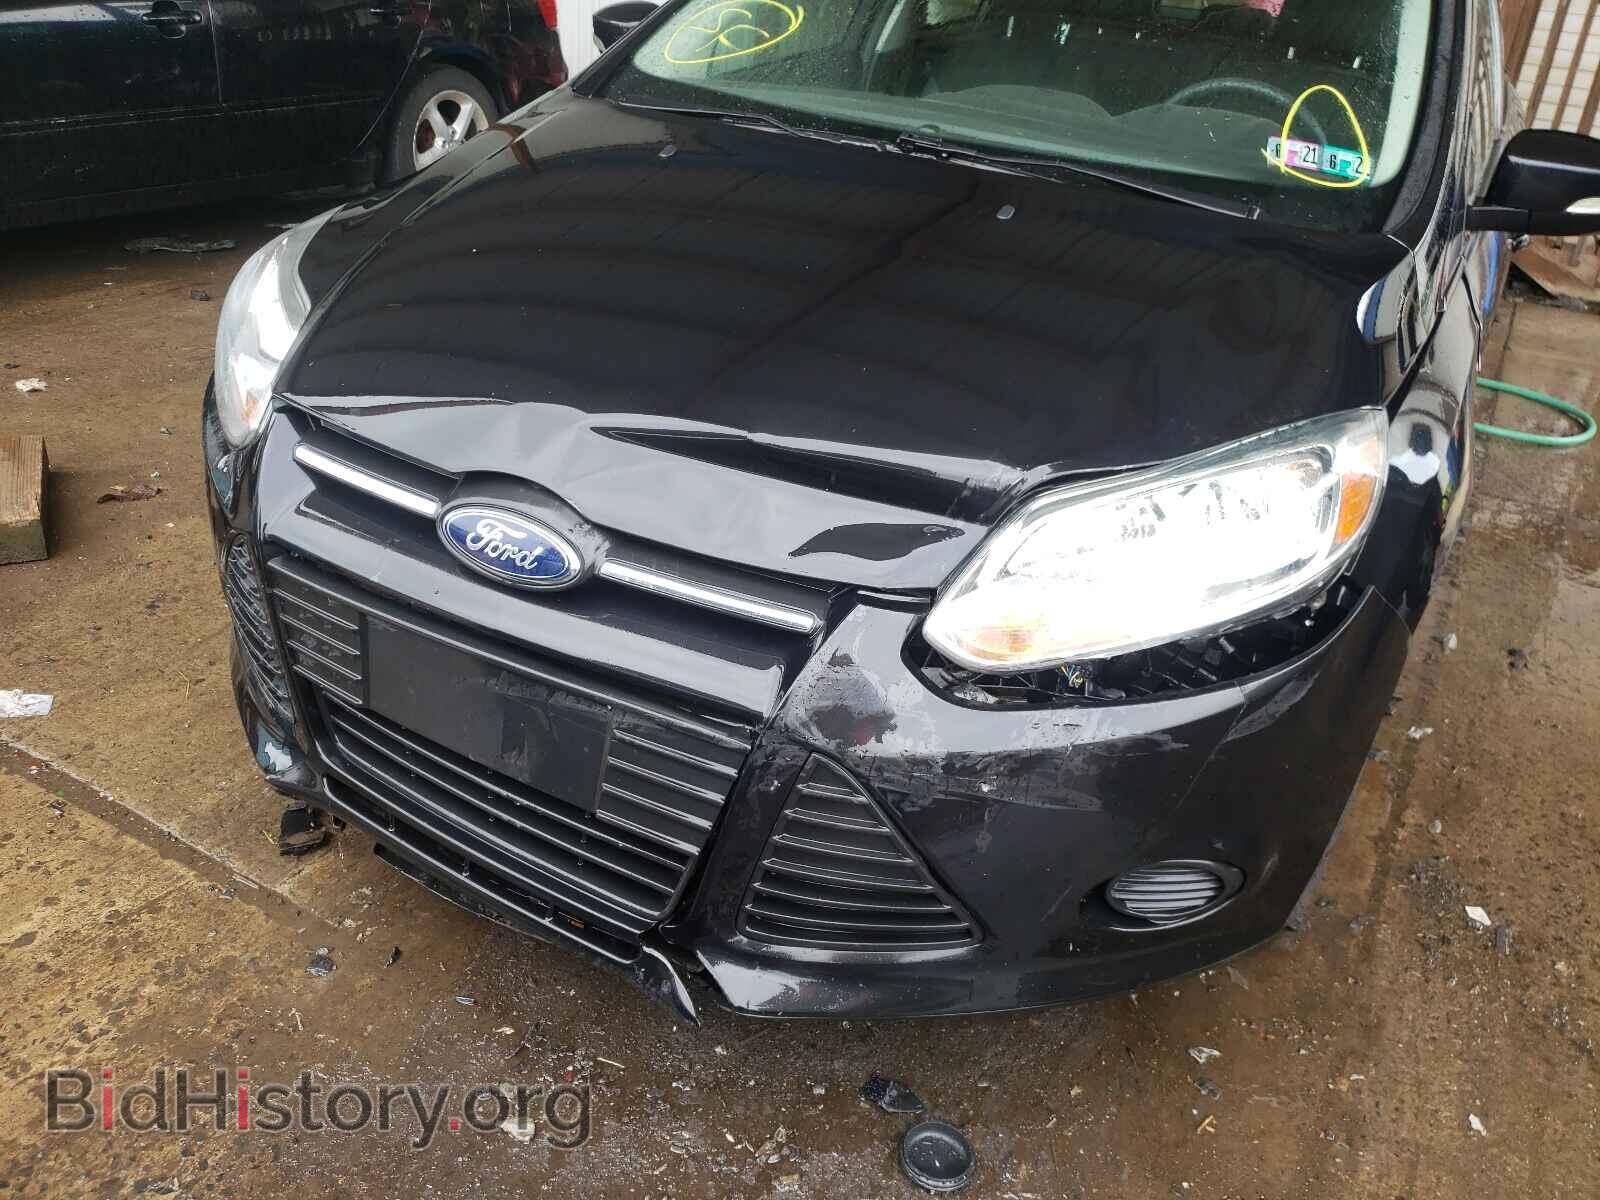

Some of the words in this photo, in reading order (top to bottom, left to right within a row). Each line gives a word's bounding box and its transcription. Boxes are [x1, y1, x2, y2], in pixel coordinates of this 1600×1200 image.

[1303, 145, 1317, 164] 21
[1329, 154, 1337, 170] 6
[465, 518, 545, 570] Ford
